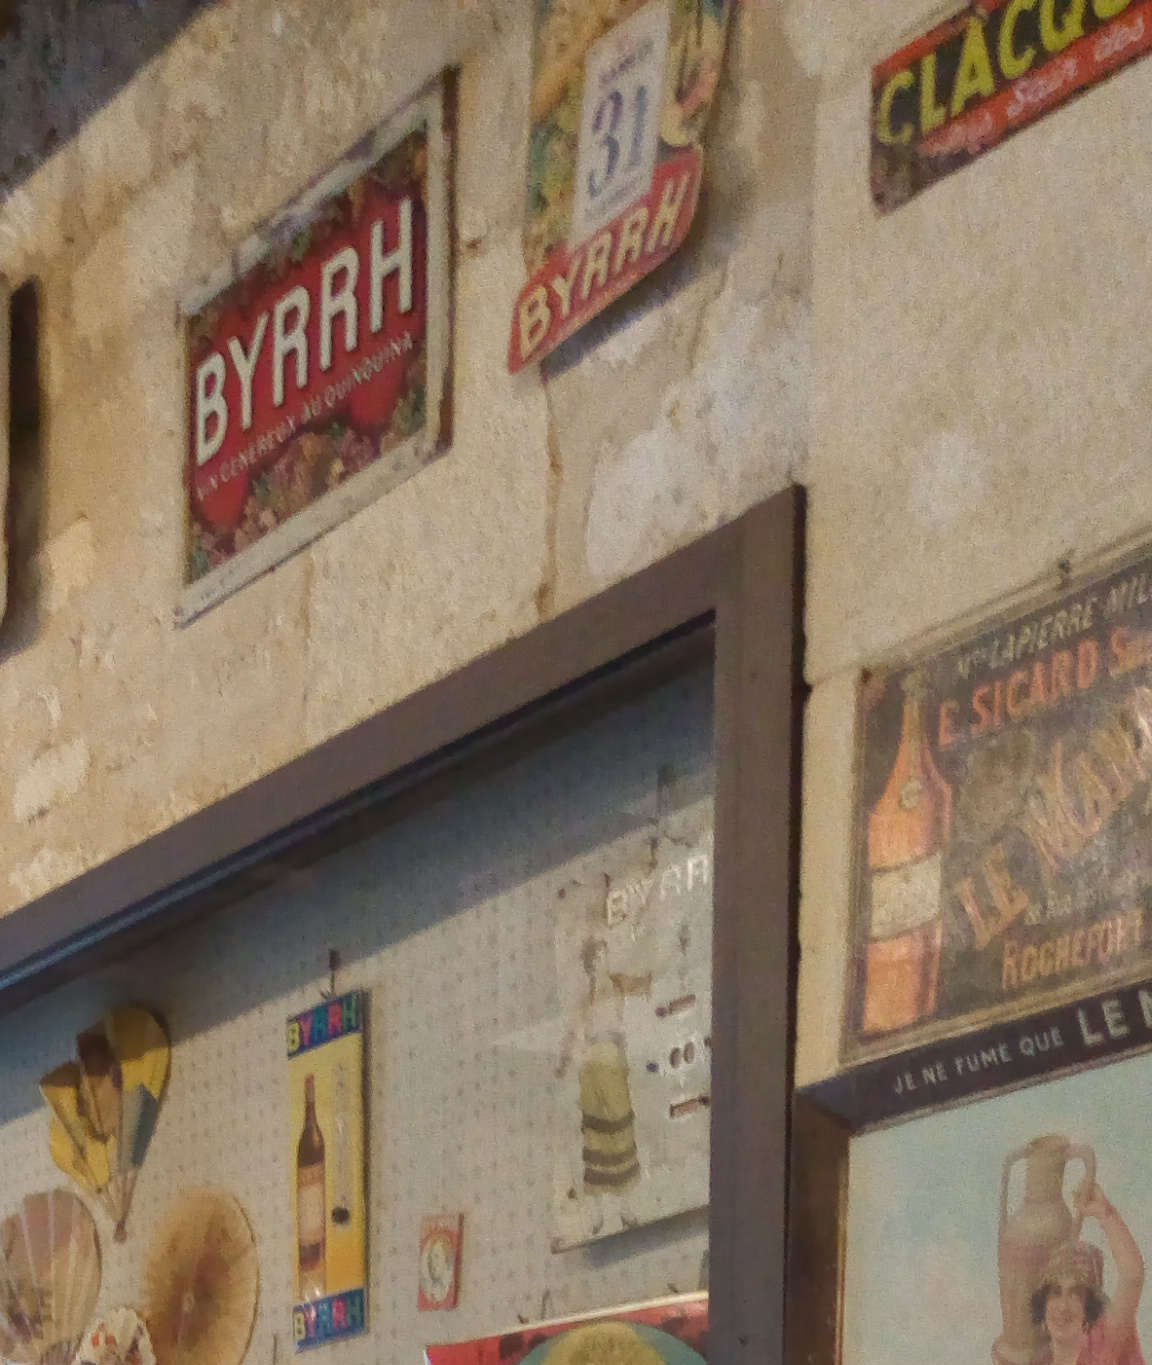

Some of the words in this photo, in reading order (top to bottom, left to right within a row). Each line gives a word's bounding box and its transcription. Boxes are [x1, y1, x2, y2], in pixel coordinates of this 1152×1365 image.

[877, 0, 1132, 147] CLACQ
[519, 172, 690, 362] BYRRH
[195, 199, 413, 466] BYRRH
[971, 639, 1099, 738] SICARD
[286, 992, 358, 1054] BYRRH
[892, 1073, 918, 1096] JE
[921, 1060, 949, 1086] NE
[953, 1042, 1013, 1077] FUME
[1018, 1026, 1065, 1057] QUE
[1076, 998, 1131, 1048] LE
[293, 1294, 362, 1341] BYRRH
